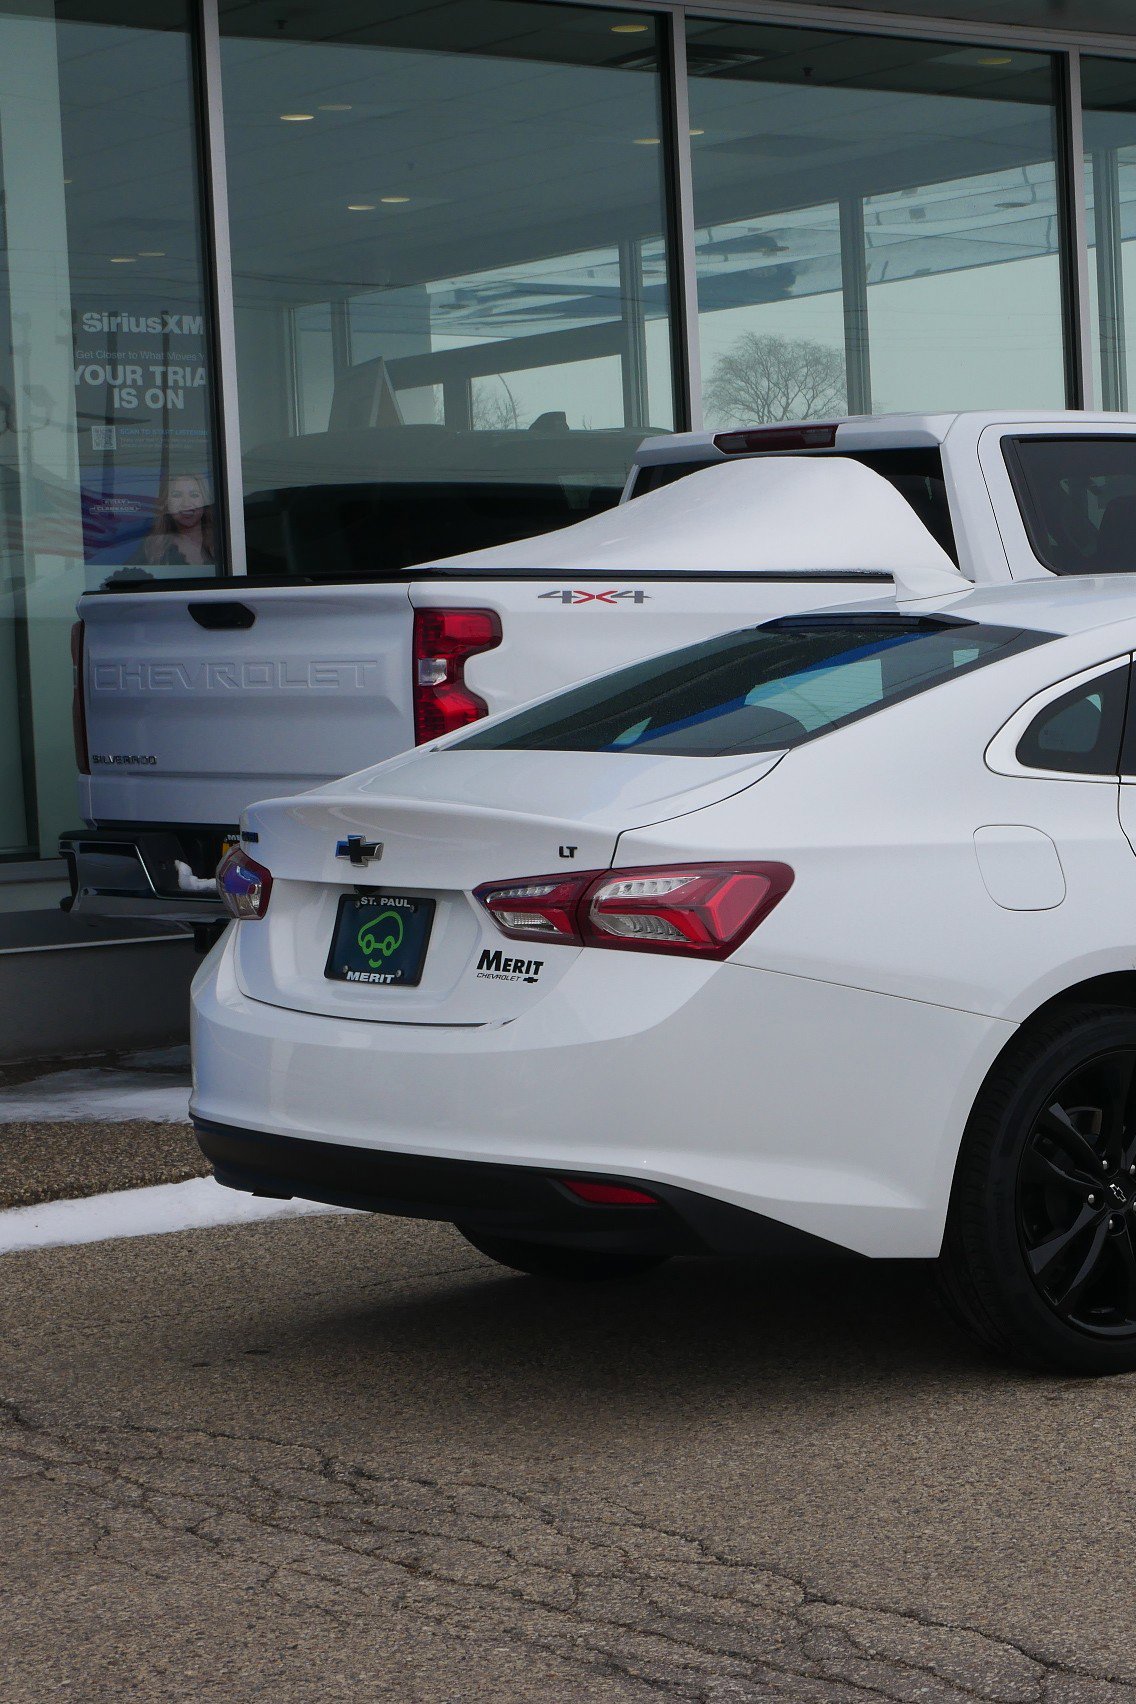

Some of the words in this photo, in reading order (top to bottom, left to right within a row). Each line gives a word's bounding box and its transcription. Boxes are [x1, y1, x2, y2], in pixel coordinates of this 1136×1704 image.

[82, 312, 203, 334] SiriusXM
[76, 350, 94, 359] Get
[96, 350, 126, 359] Closer
[128, 351, 138, 359] to
[139, 351, 164, 360] What
[167, 352, 197, 361] Moves
[74, 365, 143, 386] YOUR
[114, 388, 138, 409] IS
[145, 388, 185, 409] ON
[94, 660, 377, 690] CHEVROLET
[92, 754, 157, 765] SILVERADO
[558, 845, 578, 858] LT
[360, 896, 377, 905] ST.
[380, 898, 411, 907] PAUL
[346, 971, 395, 983] MERIT
[476, 972, 522, 982] CHEVROLET
